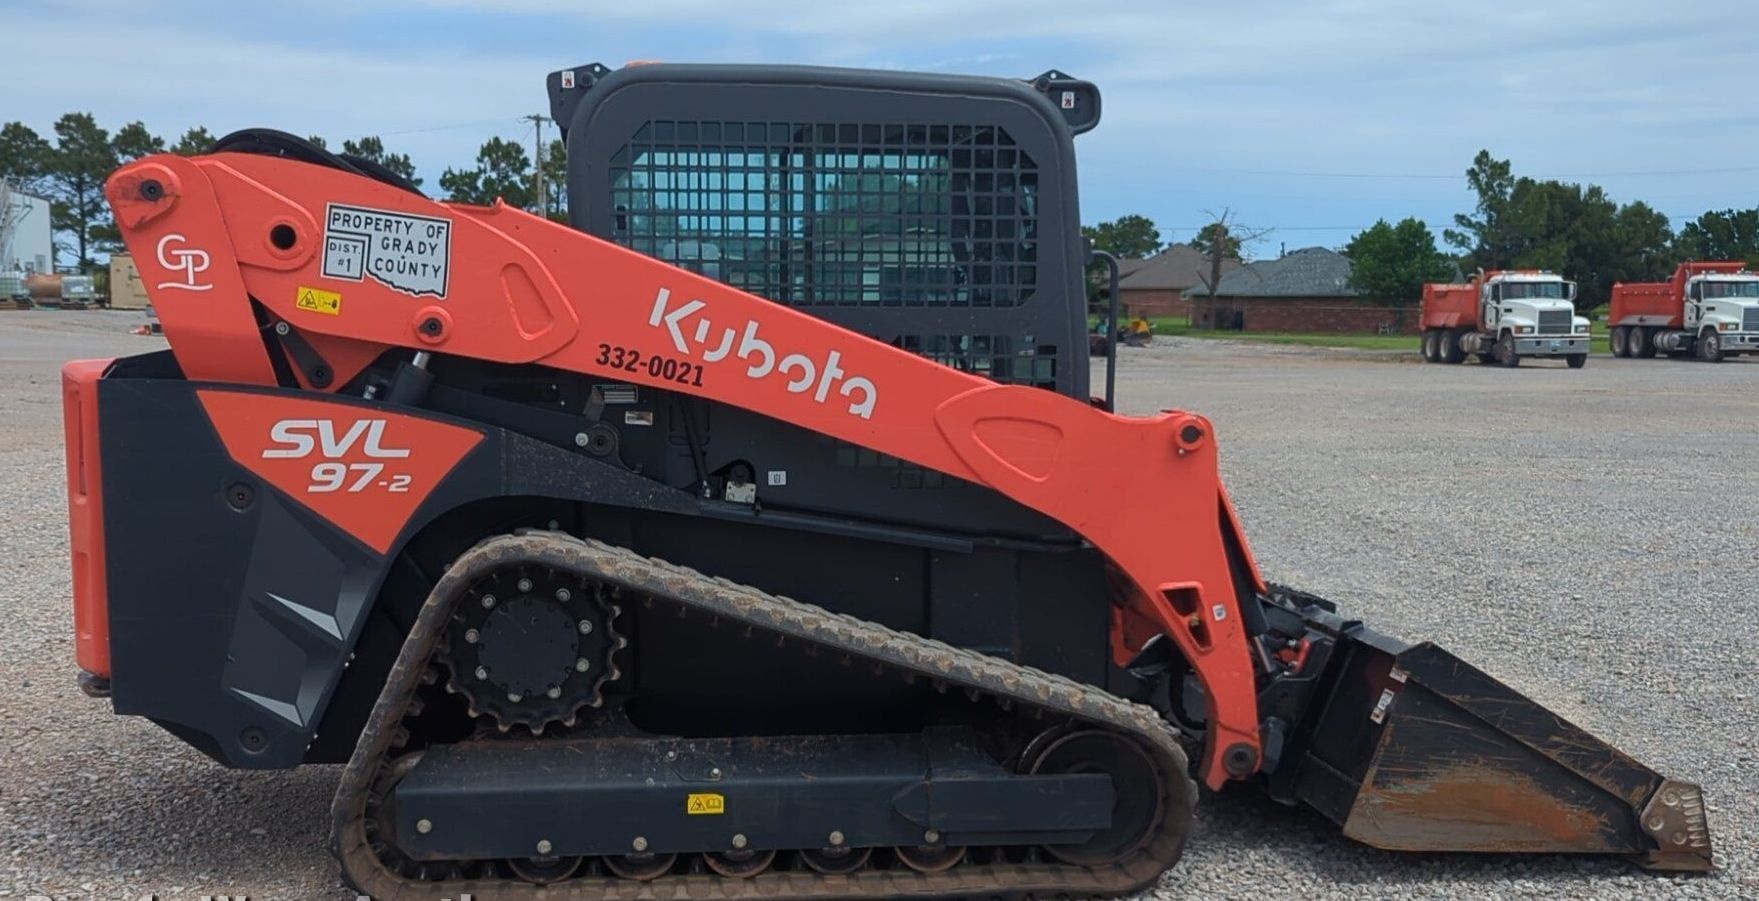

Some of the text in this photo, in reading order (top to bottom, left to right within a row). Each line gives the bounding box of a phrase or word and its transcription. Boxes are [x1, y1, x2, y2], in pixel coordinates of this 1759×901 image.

[332, 212, 445, 239] PROPERTY OF
[329, 242, 361, 255] DIST.
[381, 237, 438, 256] GRADY
[338, 258, 352, 273] #1
[375, 258, 441, 278] COUNTY
[595, 344, 704, 387] 332-0021
[649, 287, 877, 420] Kubota
[262, 419, 411, 458] SVL
[307, 462, 412, 492] 97-2
